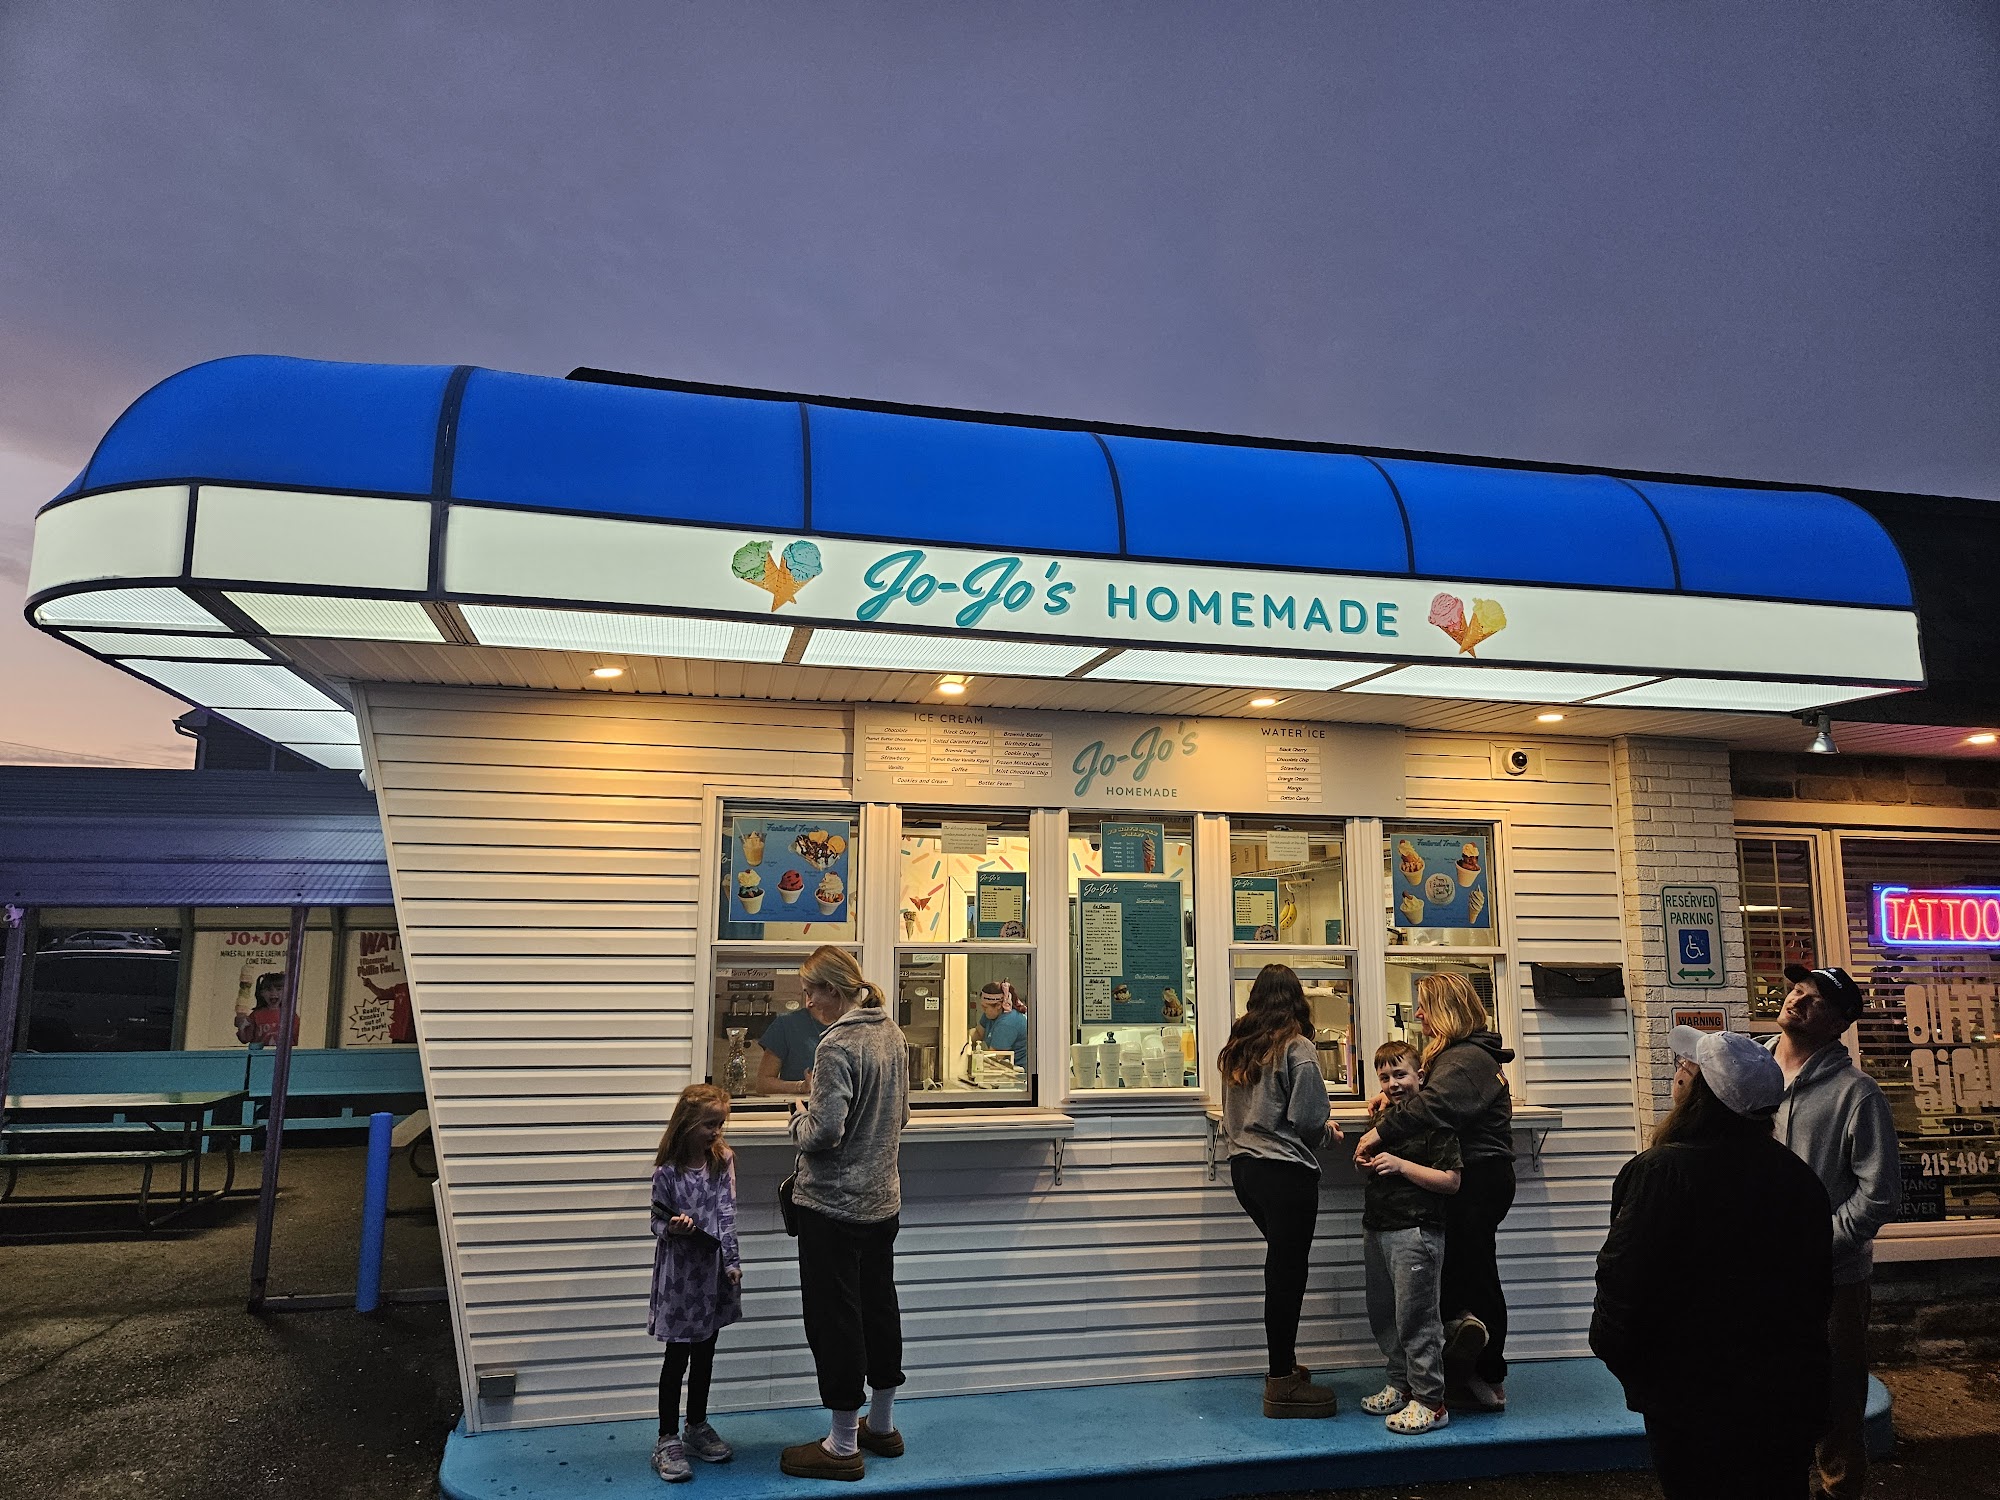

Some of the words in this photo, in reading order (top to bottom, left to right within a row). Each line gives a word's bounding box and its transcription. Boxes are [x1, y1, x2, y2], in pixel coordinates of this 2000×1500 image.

[857, 549, 1077, 630] Jo-Jo's
[1107, 583, 1400, 638] HOMEMADE
[914, 712, 934, 722] ICE
[940, 714, 983, 724] CREAM
[1261, 727, 1302, 738] WATER
[1307, 730, 1325, 738] ICE
[880, 754, 911, 762] Strawberry
[1072, 720, 1199, 797] Jo-Jo's
[1106, 786, 1178, 798] HOMEMADE
[1443, 839, 1461, 848] Treats
[1083, 882, 1118, 897] Jo-Jo's
[1665, 894, 1716, 909] RESERVED
[1670, 911, 1714, 926] PARKING
[1884, 898, 2000, 941] TATTOO
[362, 1006, 381, 1014] Really
[1677, 1016, 1721, 1027] WARNING
[1901, 1178, 1937, 1192] TANG
[1896, 1201, 1937, 1216] REVER
